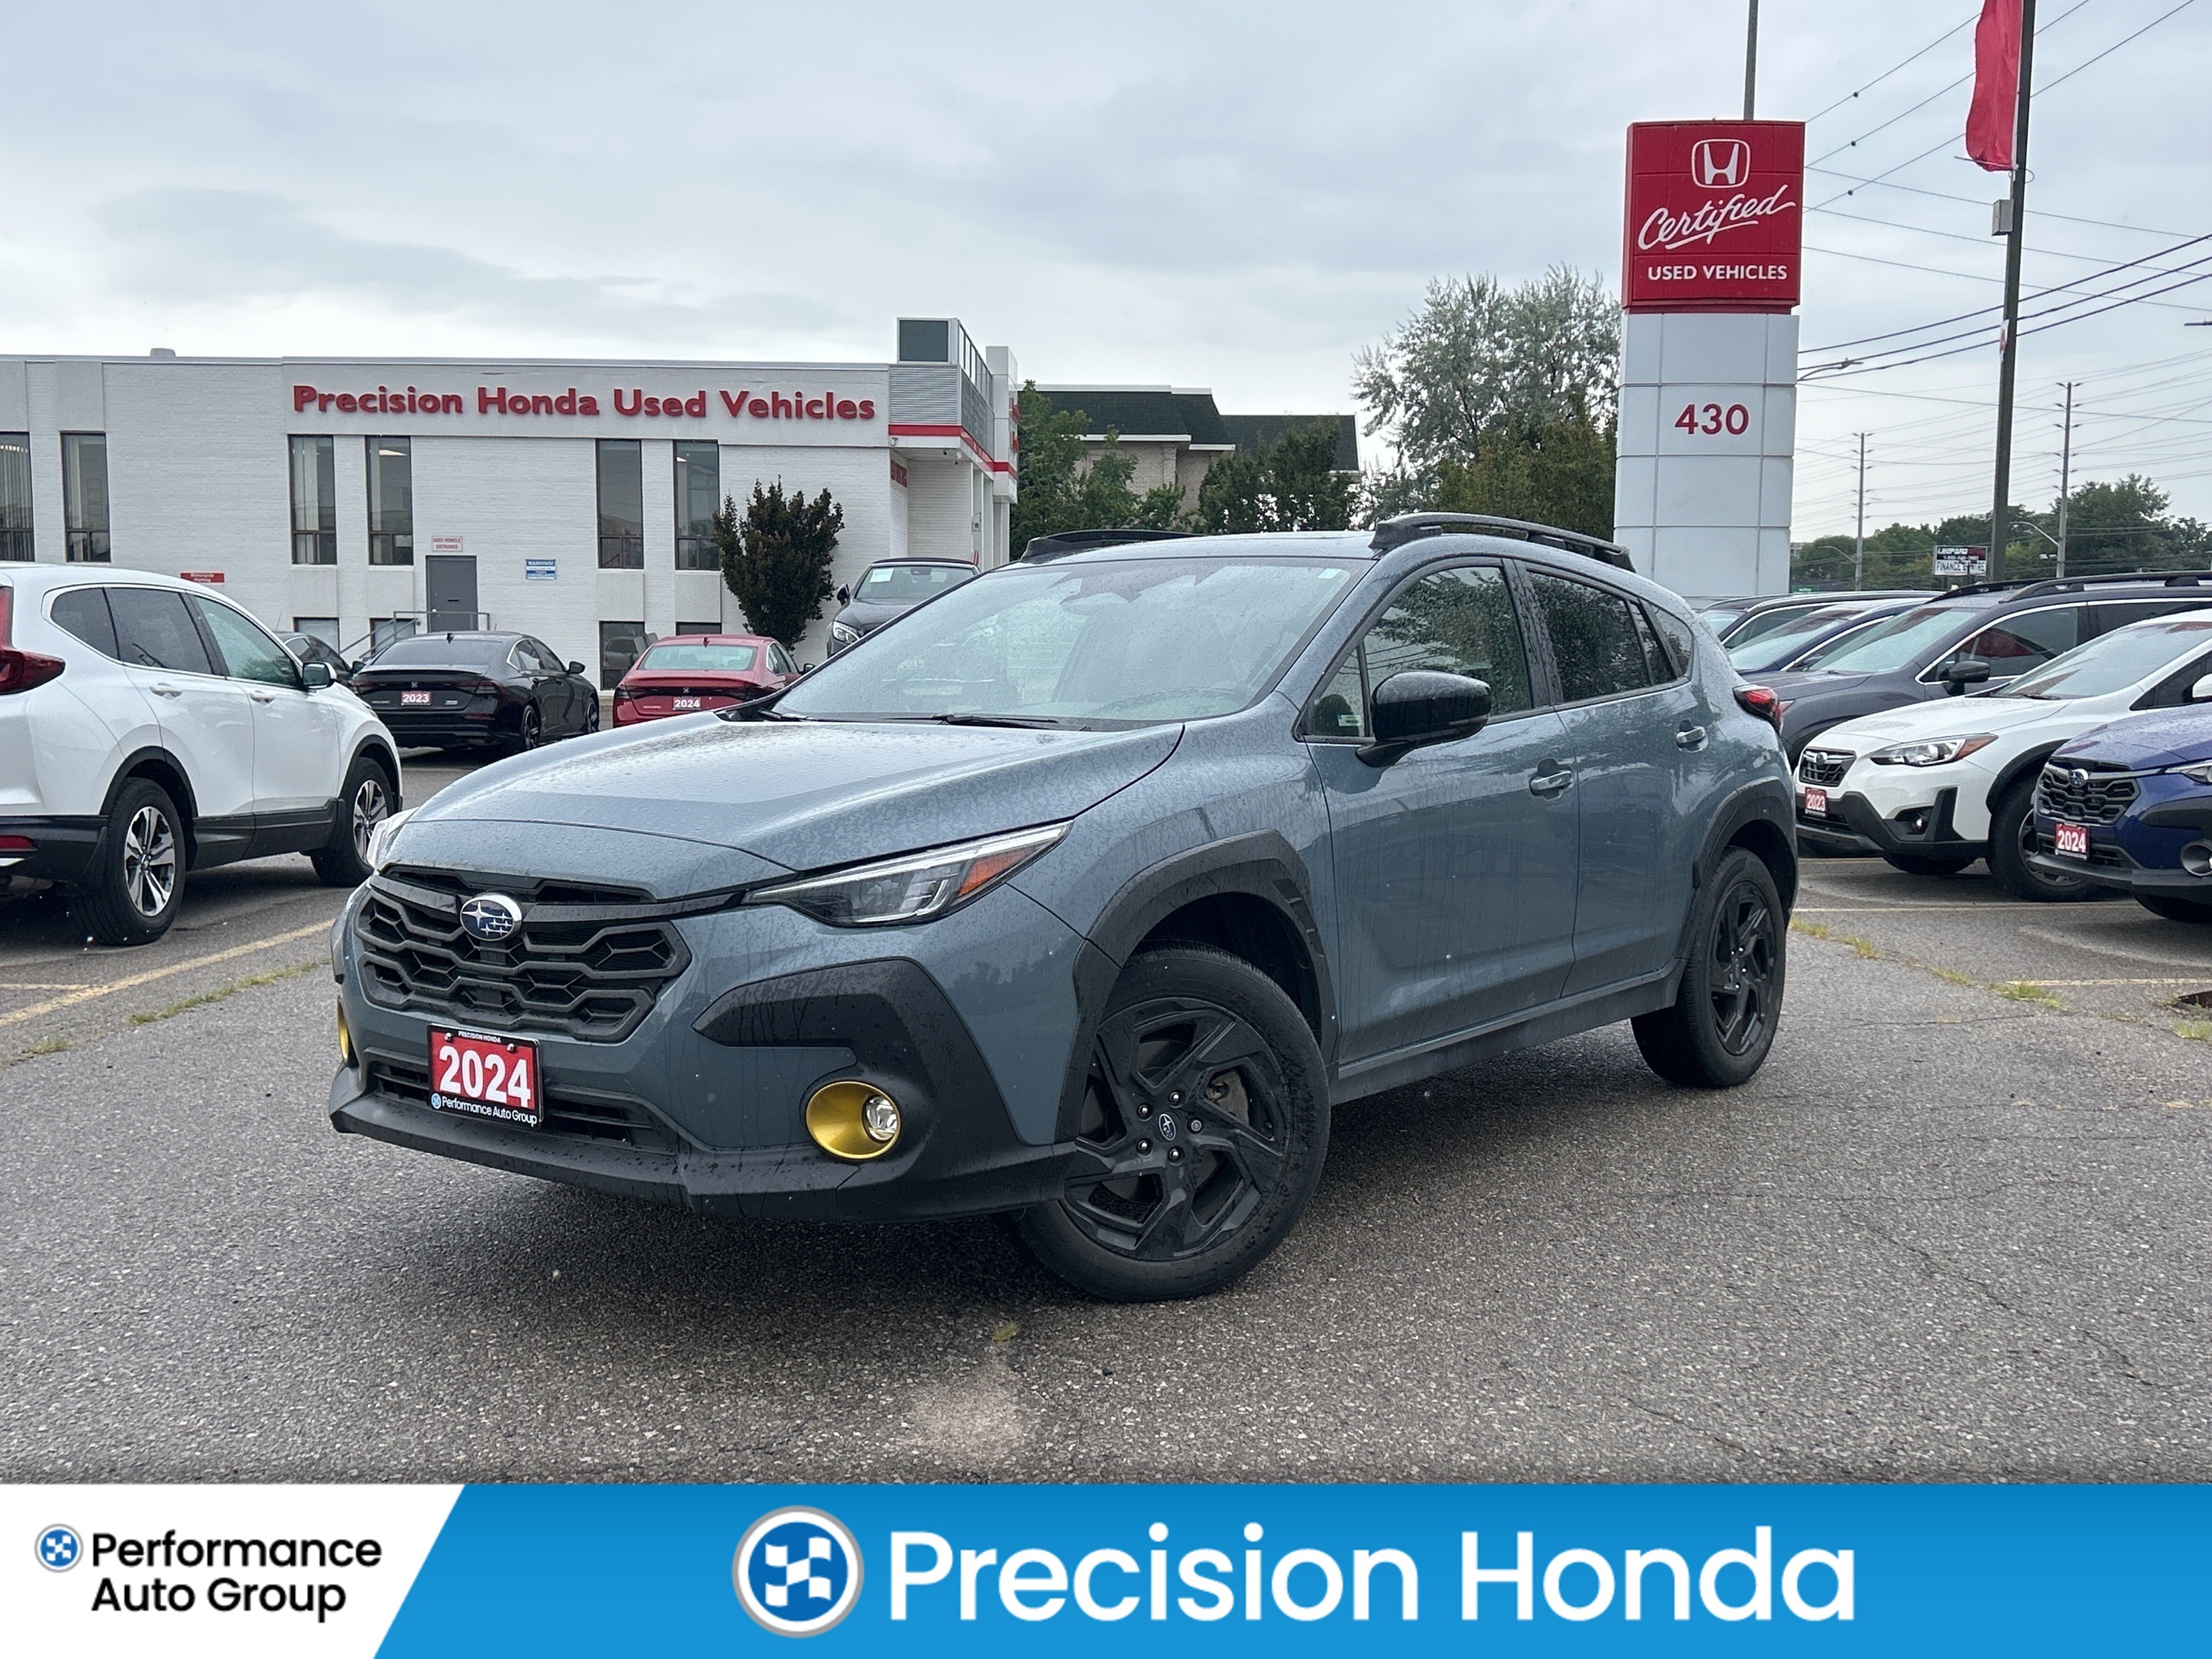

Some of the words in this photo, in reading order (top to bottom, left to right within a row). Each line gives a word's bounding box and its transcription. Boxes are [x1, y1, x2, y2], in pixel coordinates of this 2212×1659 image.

[1637, 184, 1796, 250] Certified
[1647, 266, 1697, 280] USED
[1702, 265, 1788, 280] VEHICLES
[293, 385, 463, 413] Precision
[477, 386, 600, 416] Honda
[613, 389, 707, 418] Used
[719, 390, 876, 420] Vehicles
[1674, 403, 1750, 435] 430
[1962, 561, 1985, 572] CNTRE
[402, 694, 429, 703] 2023
[674, 699, 700, 708] 2024
[1806, 793, 1826, 812] 2023
[2057, 830, 2087, 853] 2024
[458, 1030, 483, 1041] PRECISION
[483, 1035, 502, 1044] HONDA
[439, 1045, 531, 1108] 2024
[442, 1096, 492, 1116] Performance
[492, 1106, 512, 1119] Auto
[512, 1110, 538, 1128] Group
